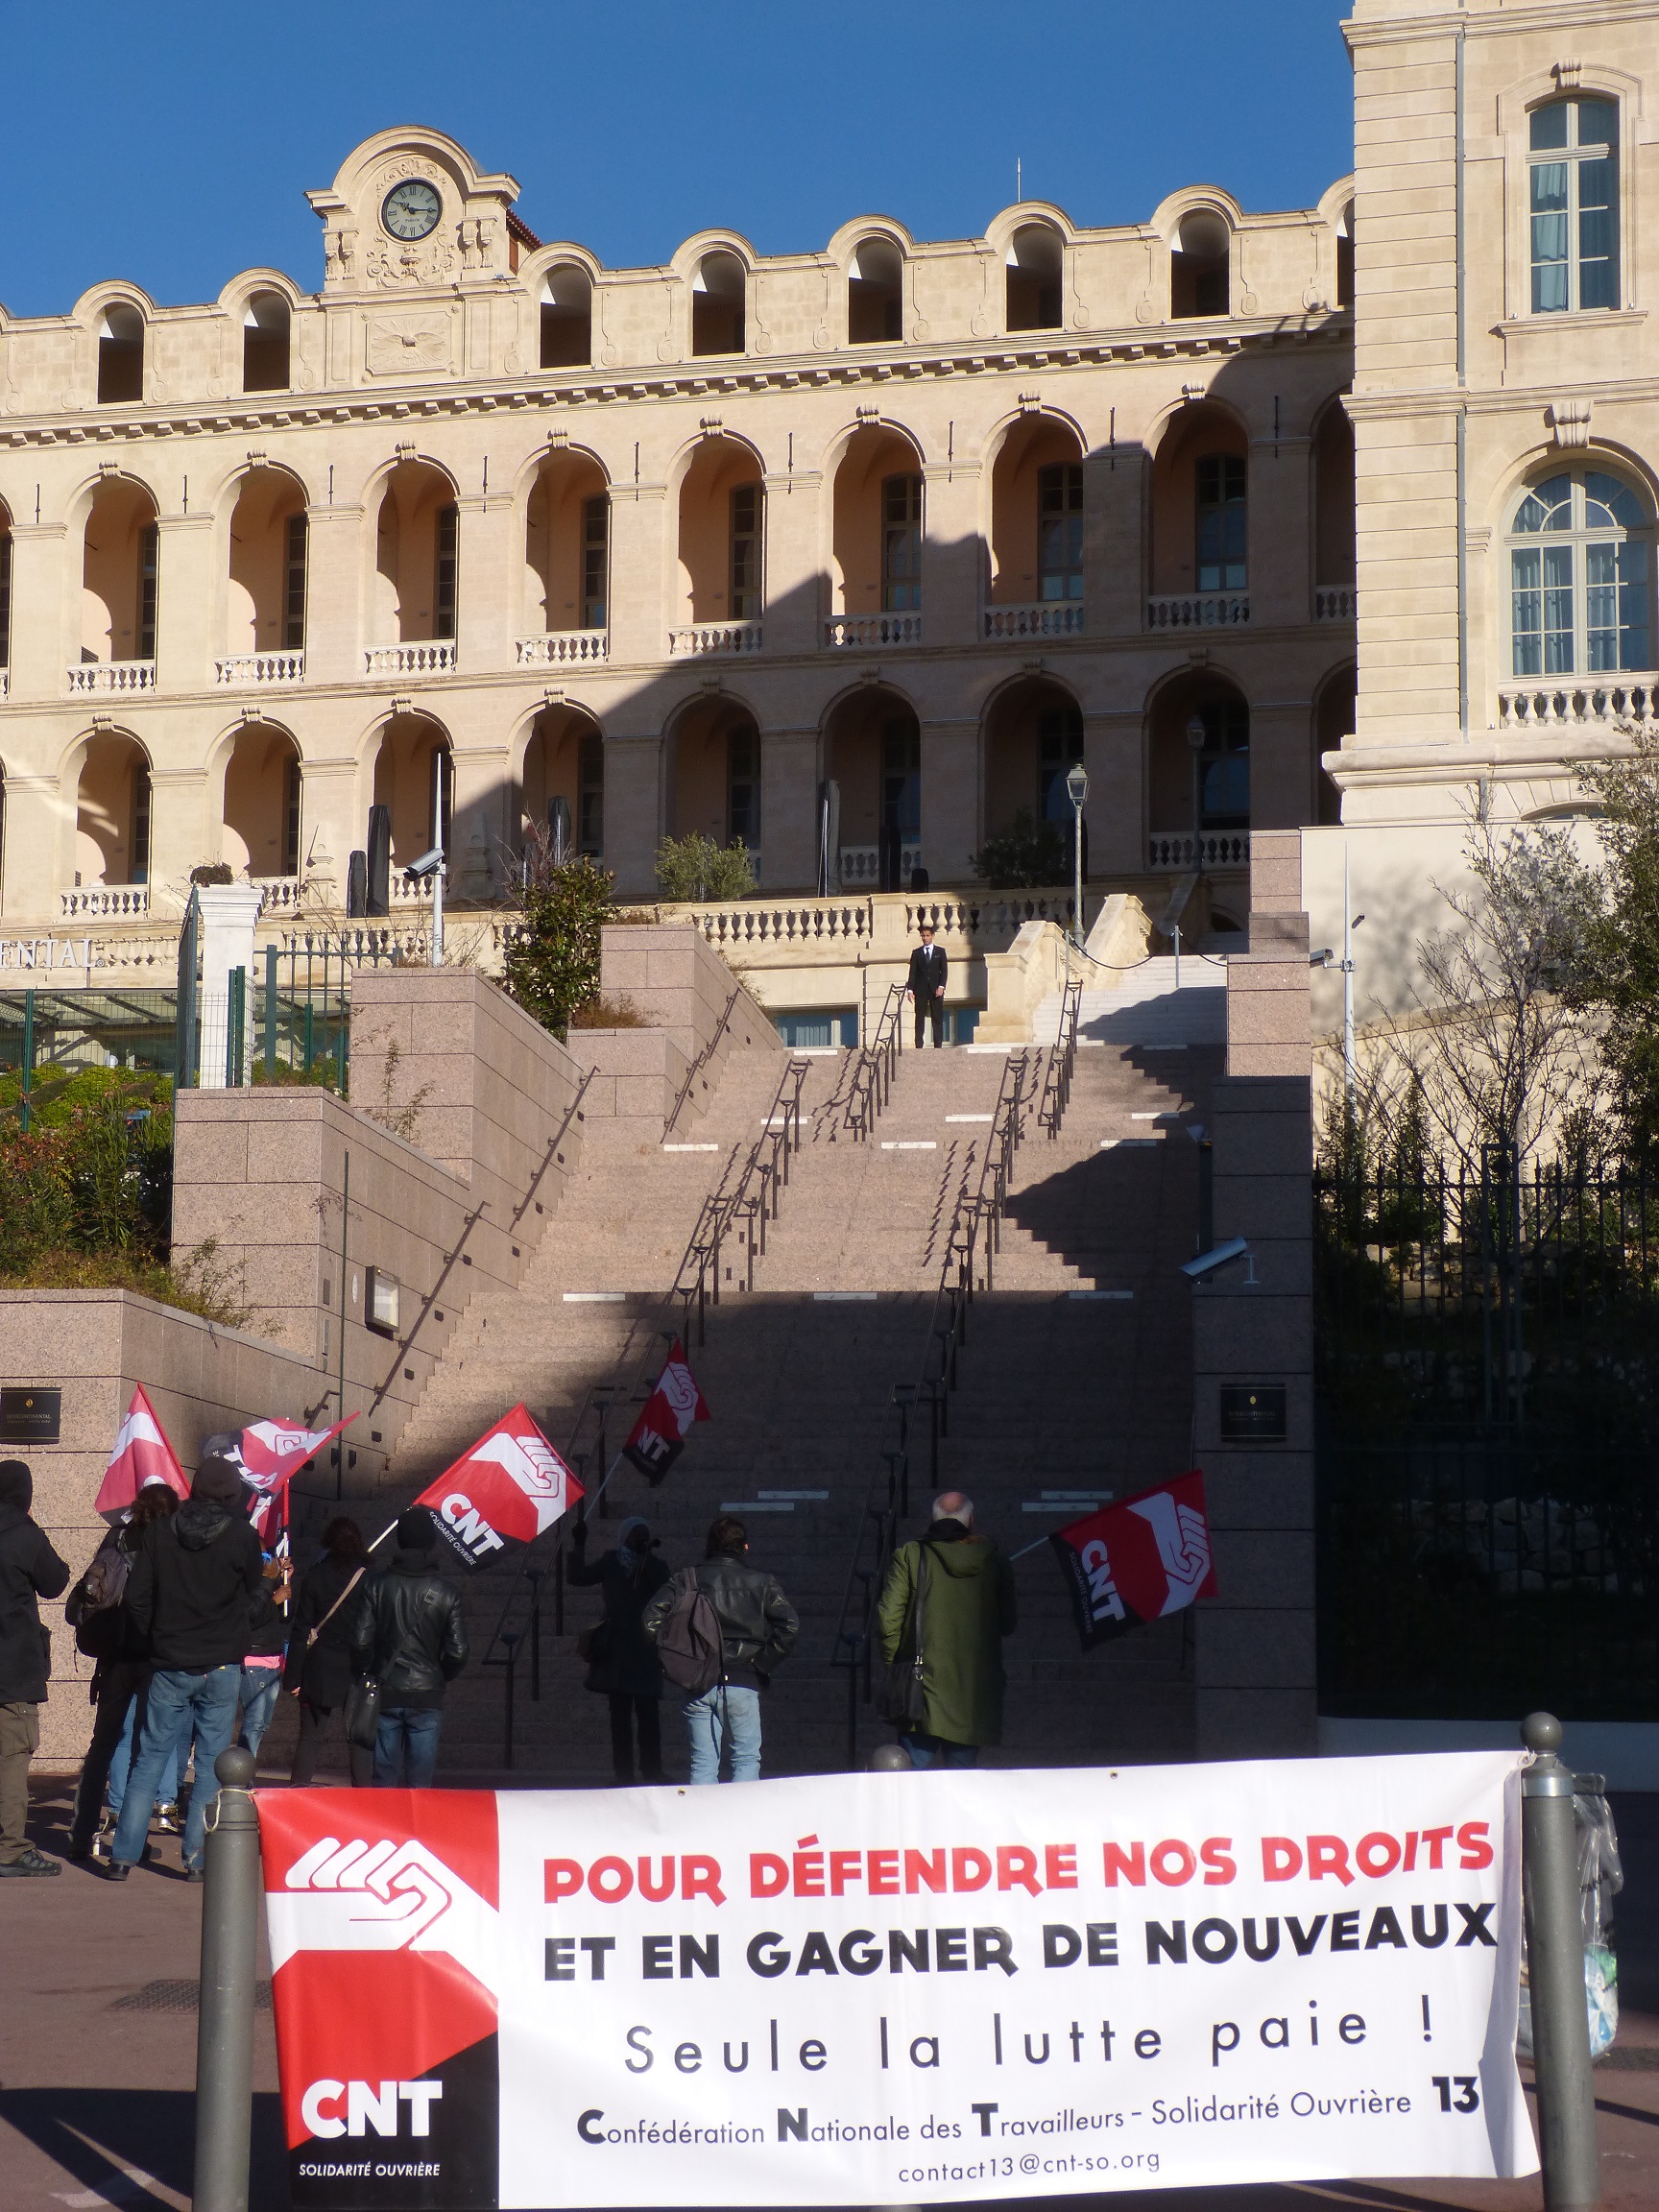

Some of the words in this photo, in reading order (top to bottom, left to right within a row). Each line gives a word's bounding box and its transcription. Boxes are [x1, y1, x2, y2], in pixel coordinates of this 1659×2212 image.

[441, 1493, 505, 1556] CNT
[1081, 1539, 1126, 1622] CNT
[544, 1855, 727, 1907] POUR
[750, 1834, 1078, 1898] DÉFENDRE
[1103, 1838, 1237, 1887] NOS
[1262, 1822, 1494, 1887] DROITS
[545, 1936, 615, 1981] ET
[642, 1935, 719, 1979] EN
[747, 1927, 1019, 1978] GAGNER
[1043, 1923, 1118, 1968] DE
[1146, 1903, 1498, 1966] NOUVEAUX
[625, 2019, 827, 2073] Seule
[880, 2017, 939, 2069] la
[994, 2013, 1161, 2065] lutte
[1213, 2000, 1366, 2067] paie
[301, 2080, 443, 2138] CNT
[577, 2108, 764, 2144] Confédération
[777, 2108, 909, 2142] Nationale
[920, 2115, 962, 2140] des
[972, 2103, 1124, 2137] Travailleurs
[1151, 2093, 1280, 2125] Solidarité
[1290, 2088, 1411, 2117] Ouvrière
[1431, 2076, 1479, 2114] 13
[299, 2161, 372, 2176] SOLIDARITÉ
[375, 2161, 441, 2176] OUVRIÈRE
[899, 2149, 1161, 2183] contact13@cnt-so.org
